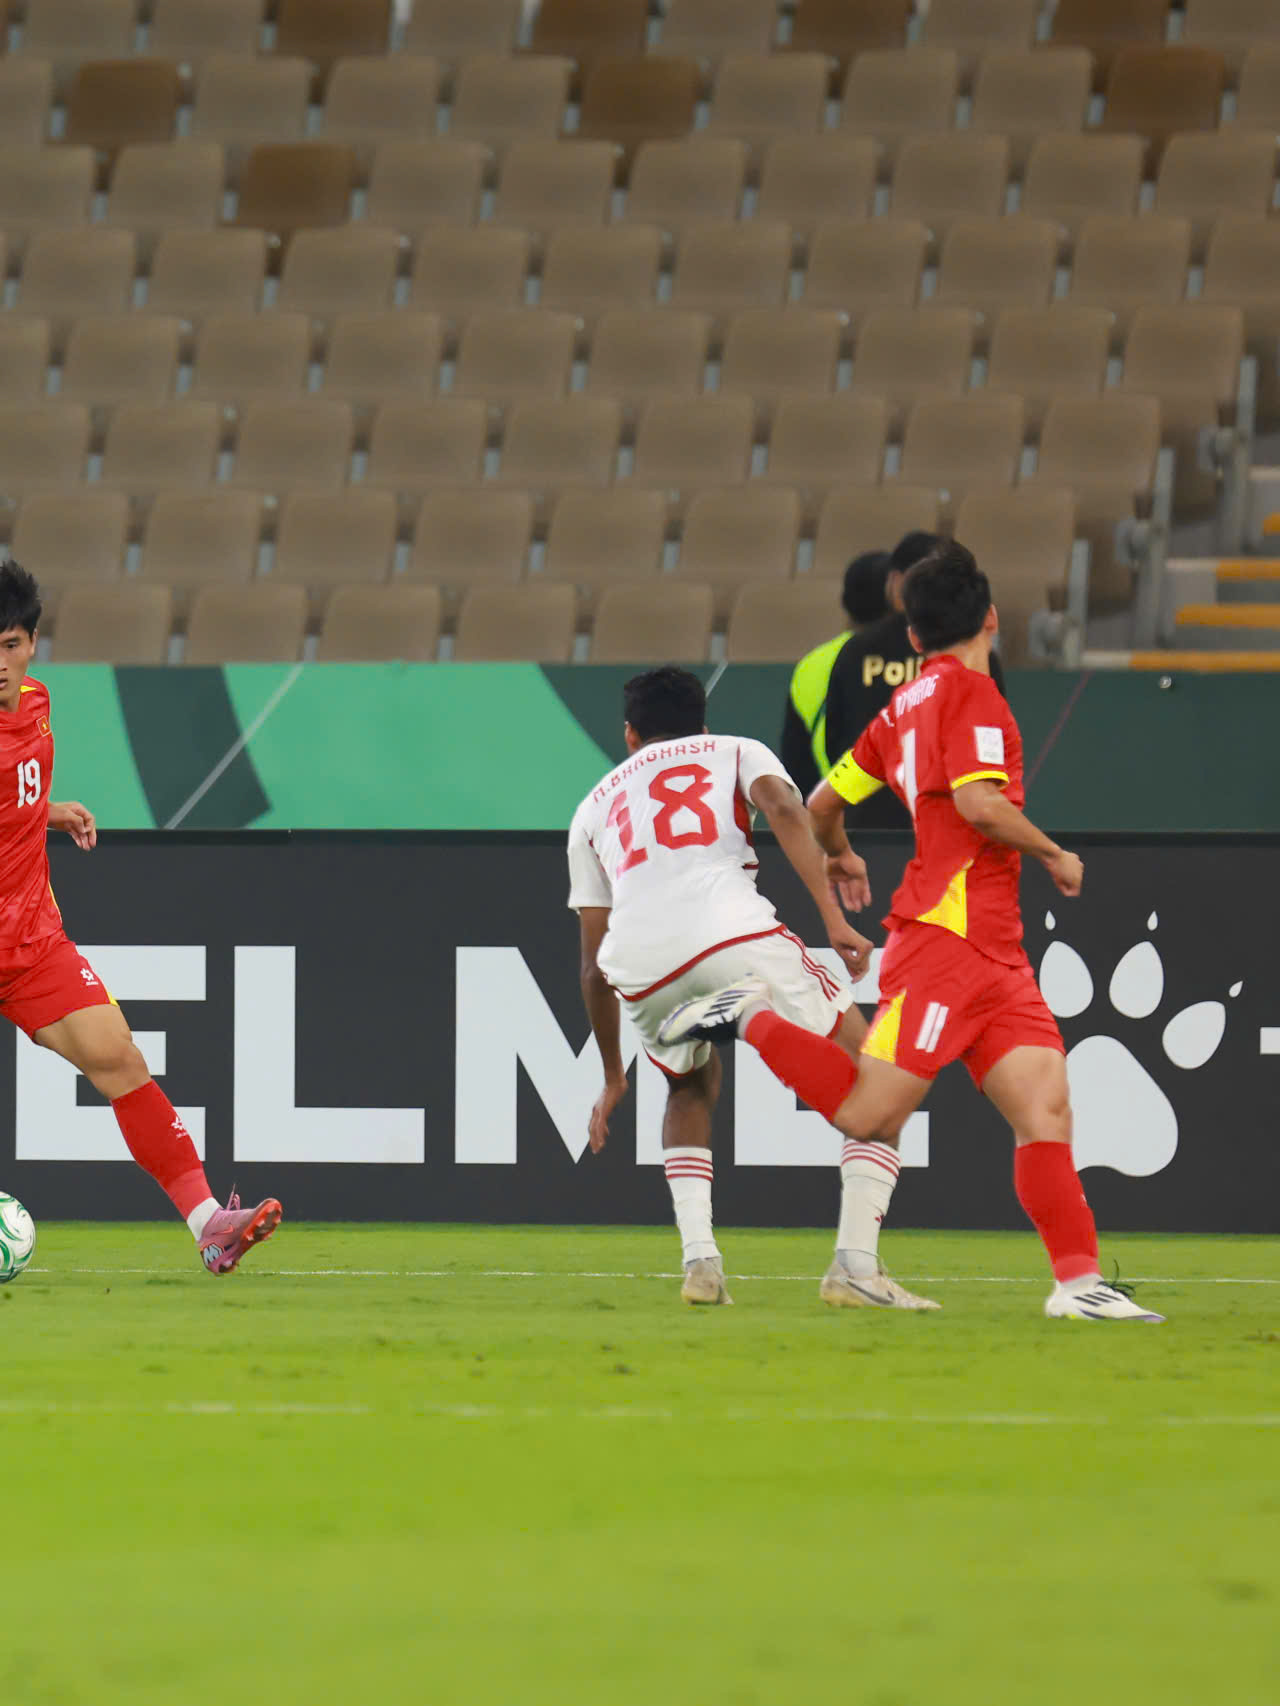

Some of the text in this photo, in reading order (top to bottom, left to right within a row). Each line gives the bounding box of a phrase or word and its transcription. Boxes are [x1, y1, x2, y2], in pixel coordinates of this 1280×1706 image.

[16, 758, 42, 809] 19
[606, 763, 720, 880] 18
[915, 1002, 949, 1053] 11
